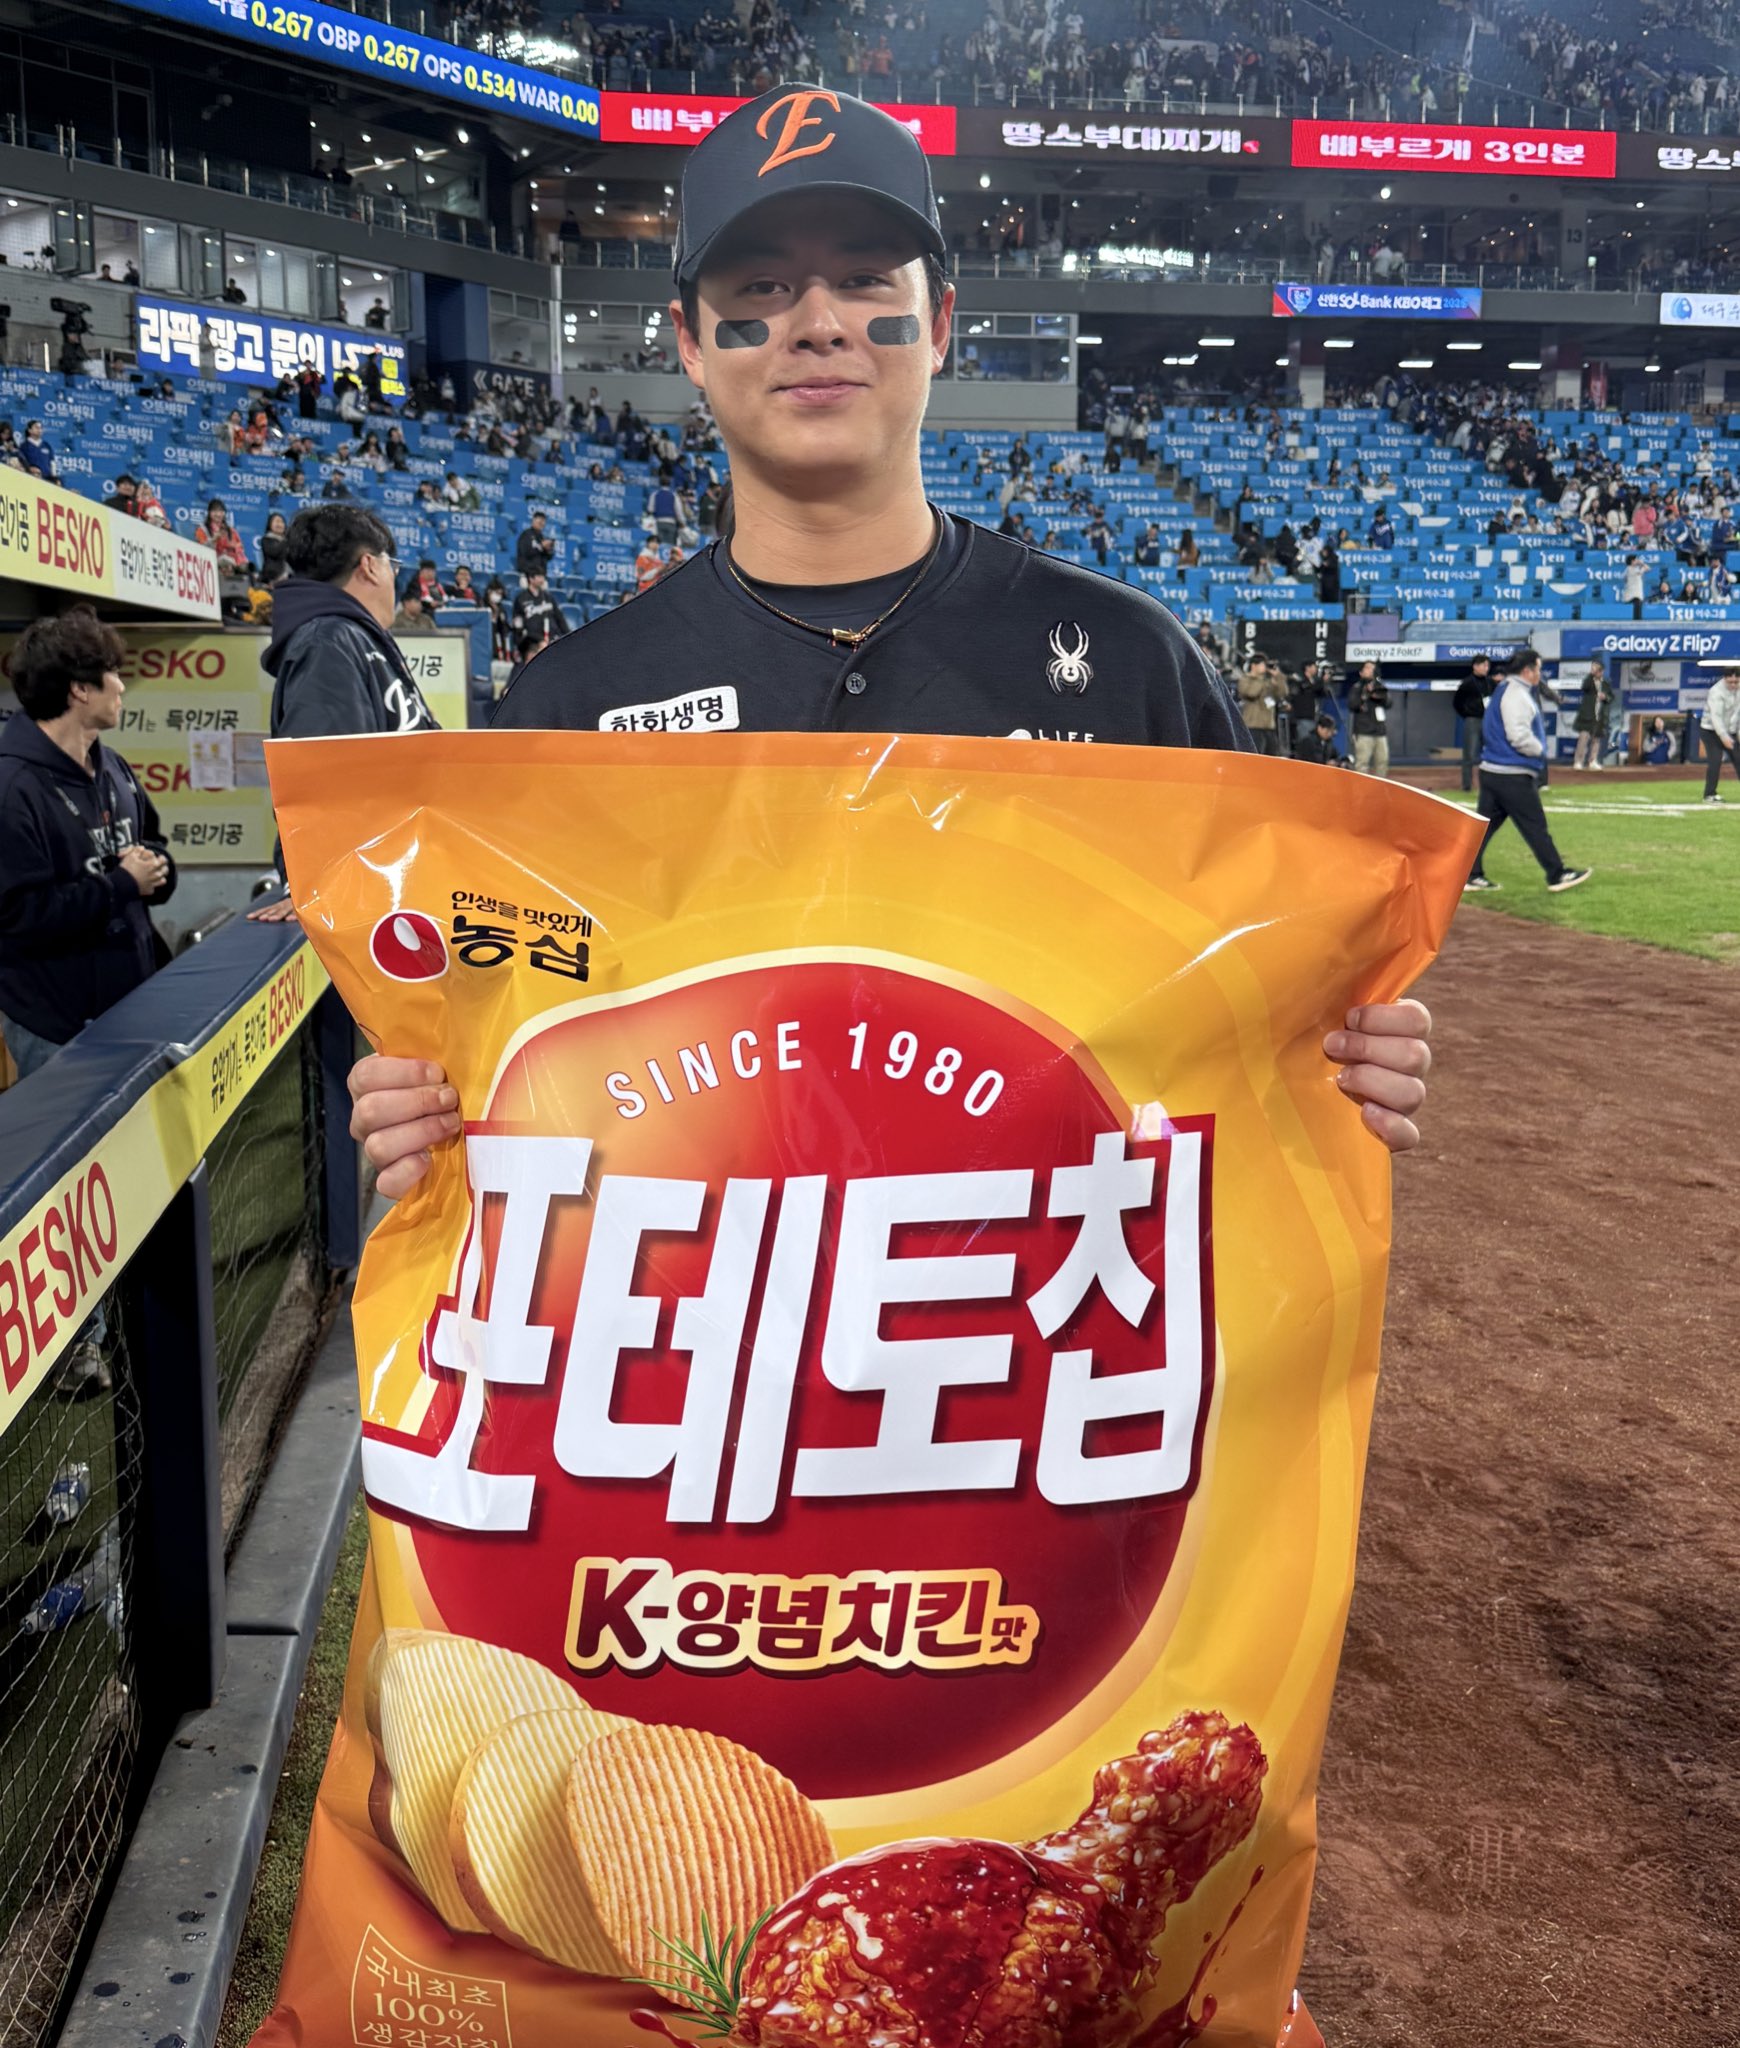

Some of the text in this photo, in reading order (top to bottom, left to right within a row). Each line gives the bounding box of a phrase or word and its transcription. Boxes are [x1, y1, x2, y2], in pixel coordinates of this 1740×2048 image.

[251, 1, 313, 41] 0.267
[317, 22, 361, 52] OBP
[364, 35, 420, 72] 0.267
[423, 54, 462, 84] OPS
[464, 65, 516, 102] 0.534
[518, 81, 561, 114] WAR
[561, 95, 599, 125] 0.00
[1320, 134, 1585, 165] 배부르게 3인분
[139, 306, 200, 368] 라팍
[206, 317, 265, 372] 광고
[37, 496, 104, 579] BESKO
[177, 549, 216, 605] BESKO
[1245, 621, 1256, 639] B
[1245, 641, 1256, 658] S
[1315, 621, 1328, 639] H
[1316, 641, 1326, 658] E
[1604, 634, 1720, 656] Galaxy Z Flip7
[119, 648, 225, 679] ESKO
[610, 694, 724, 732] 한화생명
[451, 890, 592, 938] 인생을 맛있게
[450, 914, 590, 982] 농심
[269, 954, 305, 1048] BESKO
[605, 1021, 1005, 1120] SINCE 1980
[0, 1161, 117, 1395] BESKO
[362, 1131, 1203, 1531] 포테토칩
[373, 1992, 485, 2033] 100%
